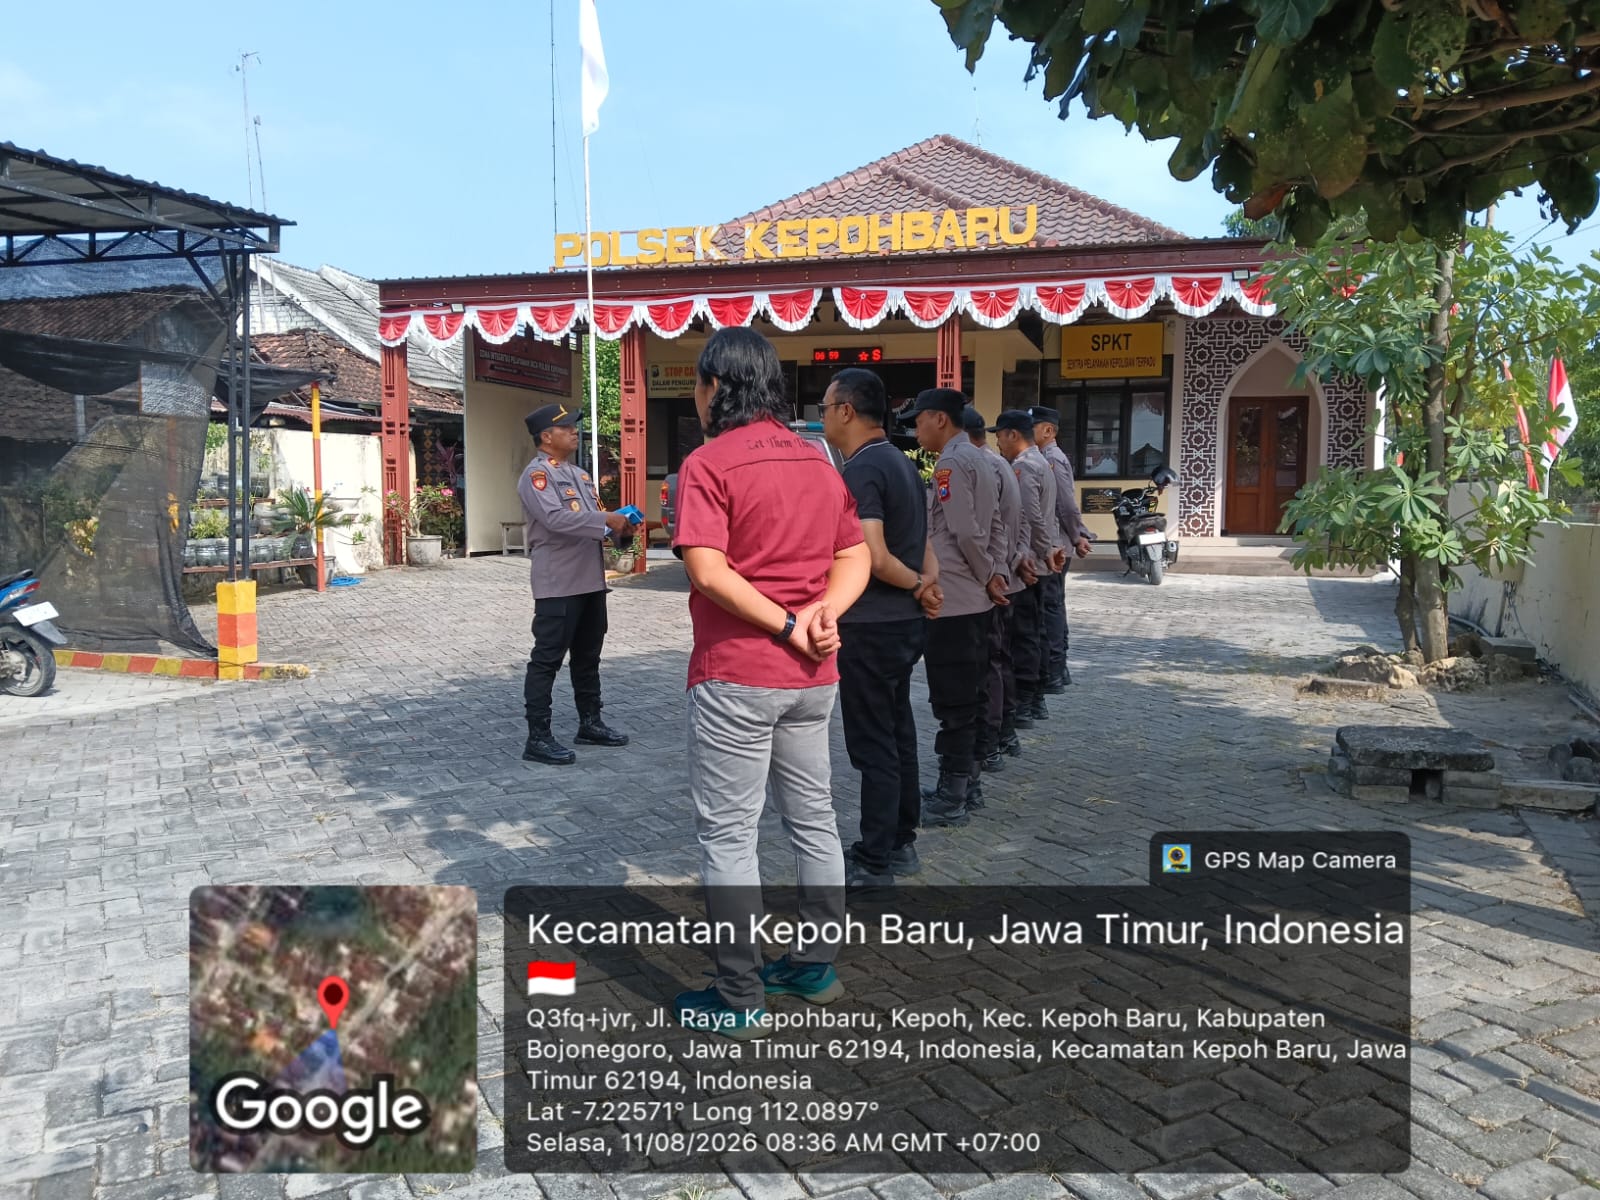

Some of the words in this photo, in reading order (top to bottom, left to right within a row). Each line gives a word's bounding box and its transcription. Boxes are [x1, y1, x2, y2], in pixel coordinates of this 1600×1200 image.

[555, 224, 729, 269] POLSEK
[744, 204, 1037, 259] KEPOHBARU
[1091, 333, 1132, 351] SPKT
